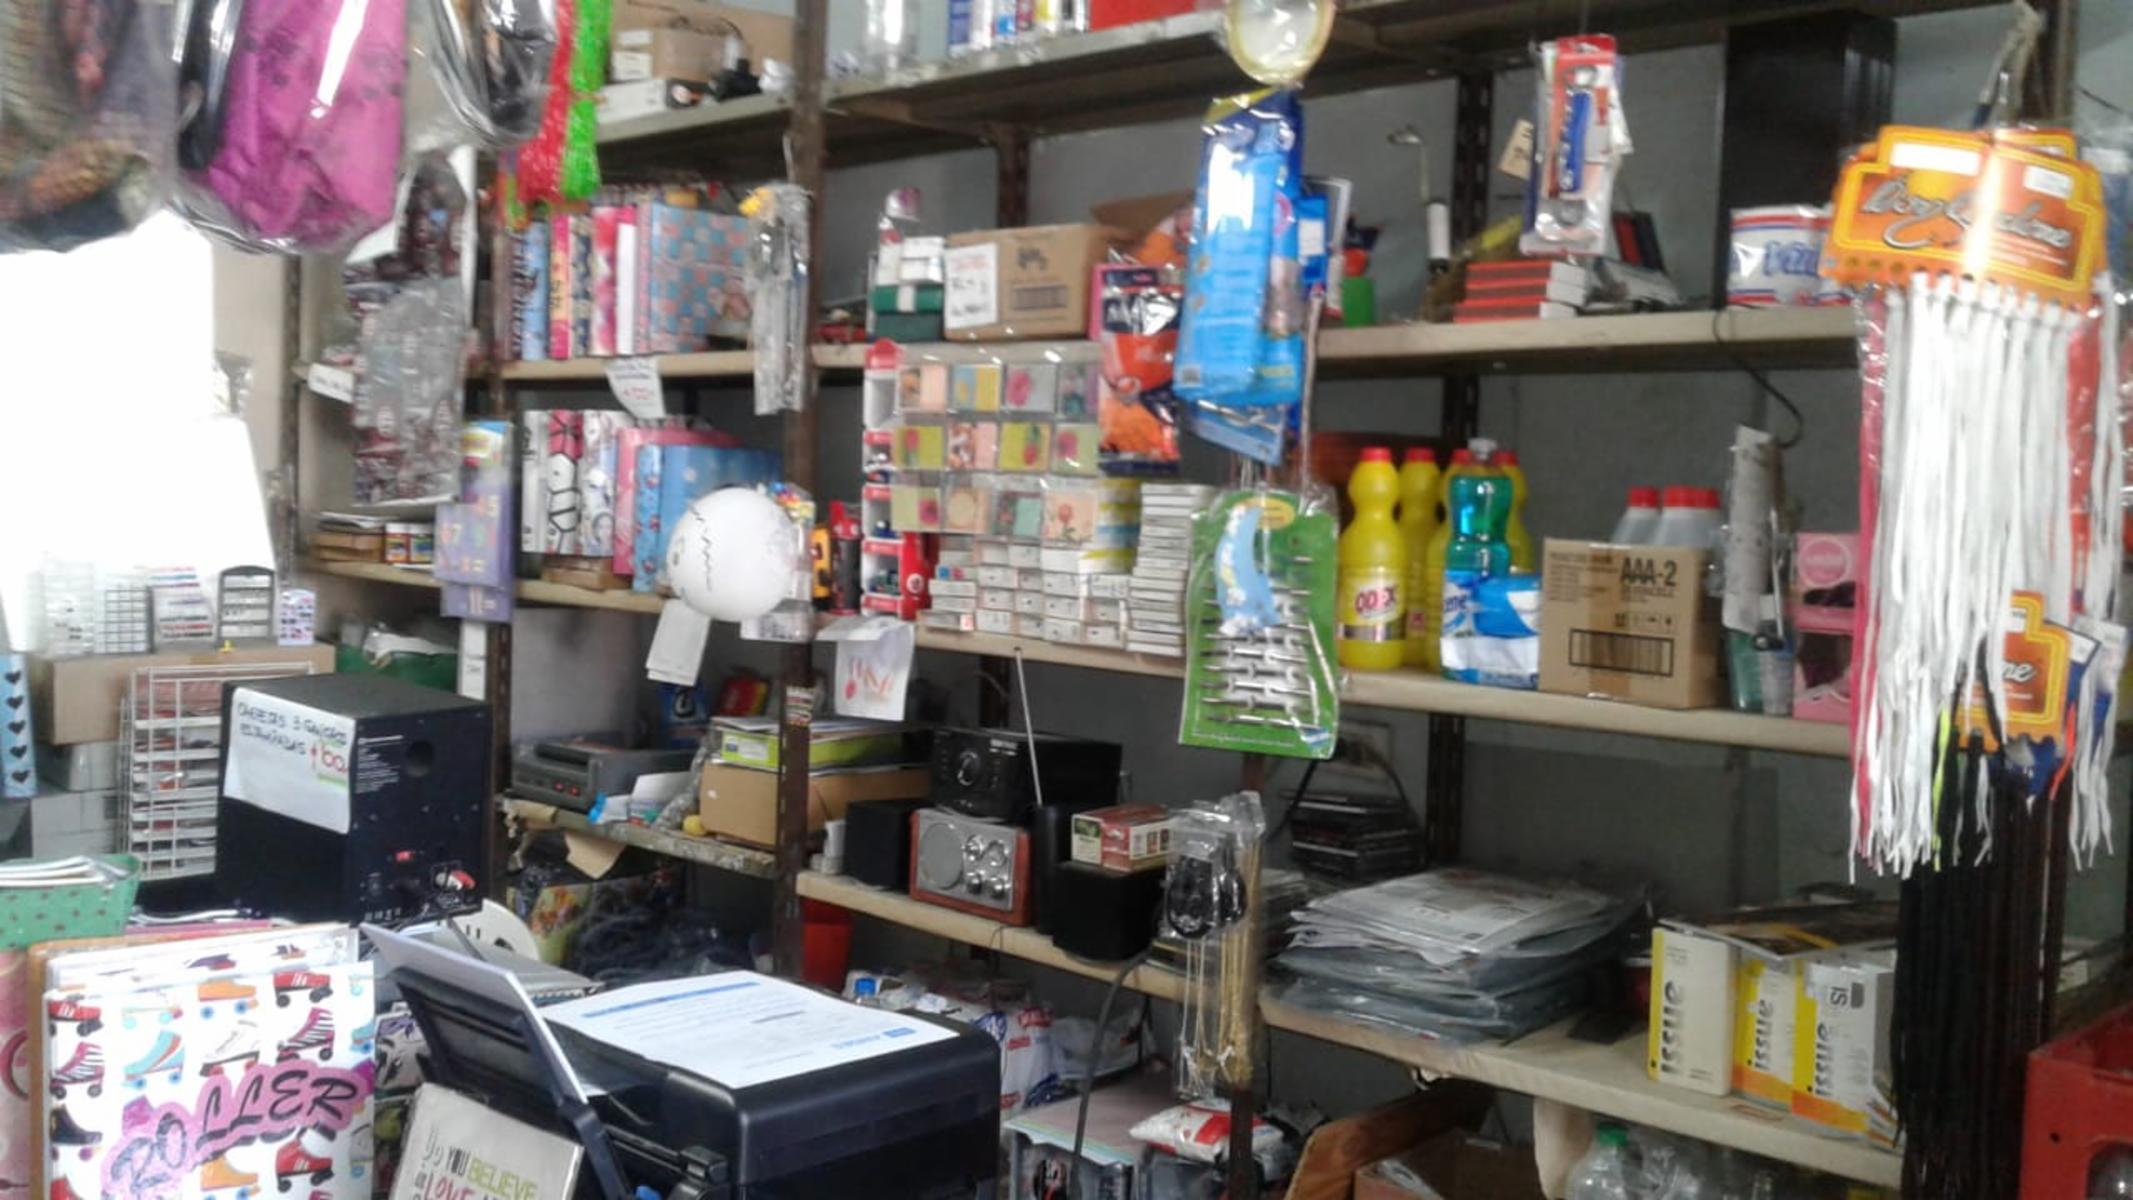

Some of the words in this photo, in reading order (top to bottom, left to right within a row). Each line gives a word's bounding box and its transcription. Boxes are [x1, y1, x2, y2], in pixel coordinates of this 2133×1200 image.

[1620, 556, 1679, 588] AAA-2
[1651, 980, 1684, 1075] issue
[1747, 998, 1773, 1071] issue
[1806, 1022, 1834, 1098] issue
[109, 1068, 359, 1194] ROLLER
[467, 1156, 538, 1200] BELIEVE
